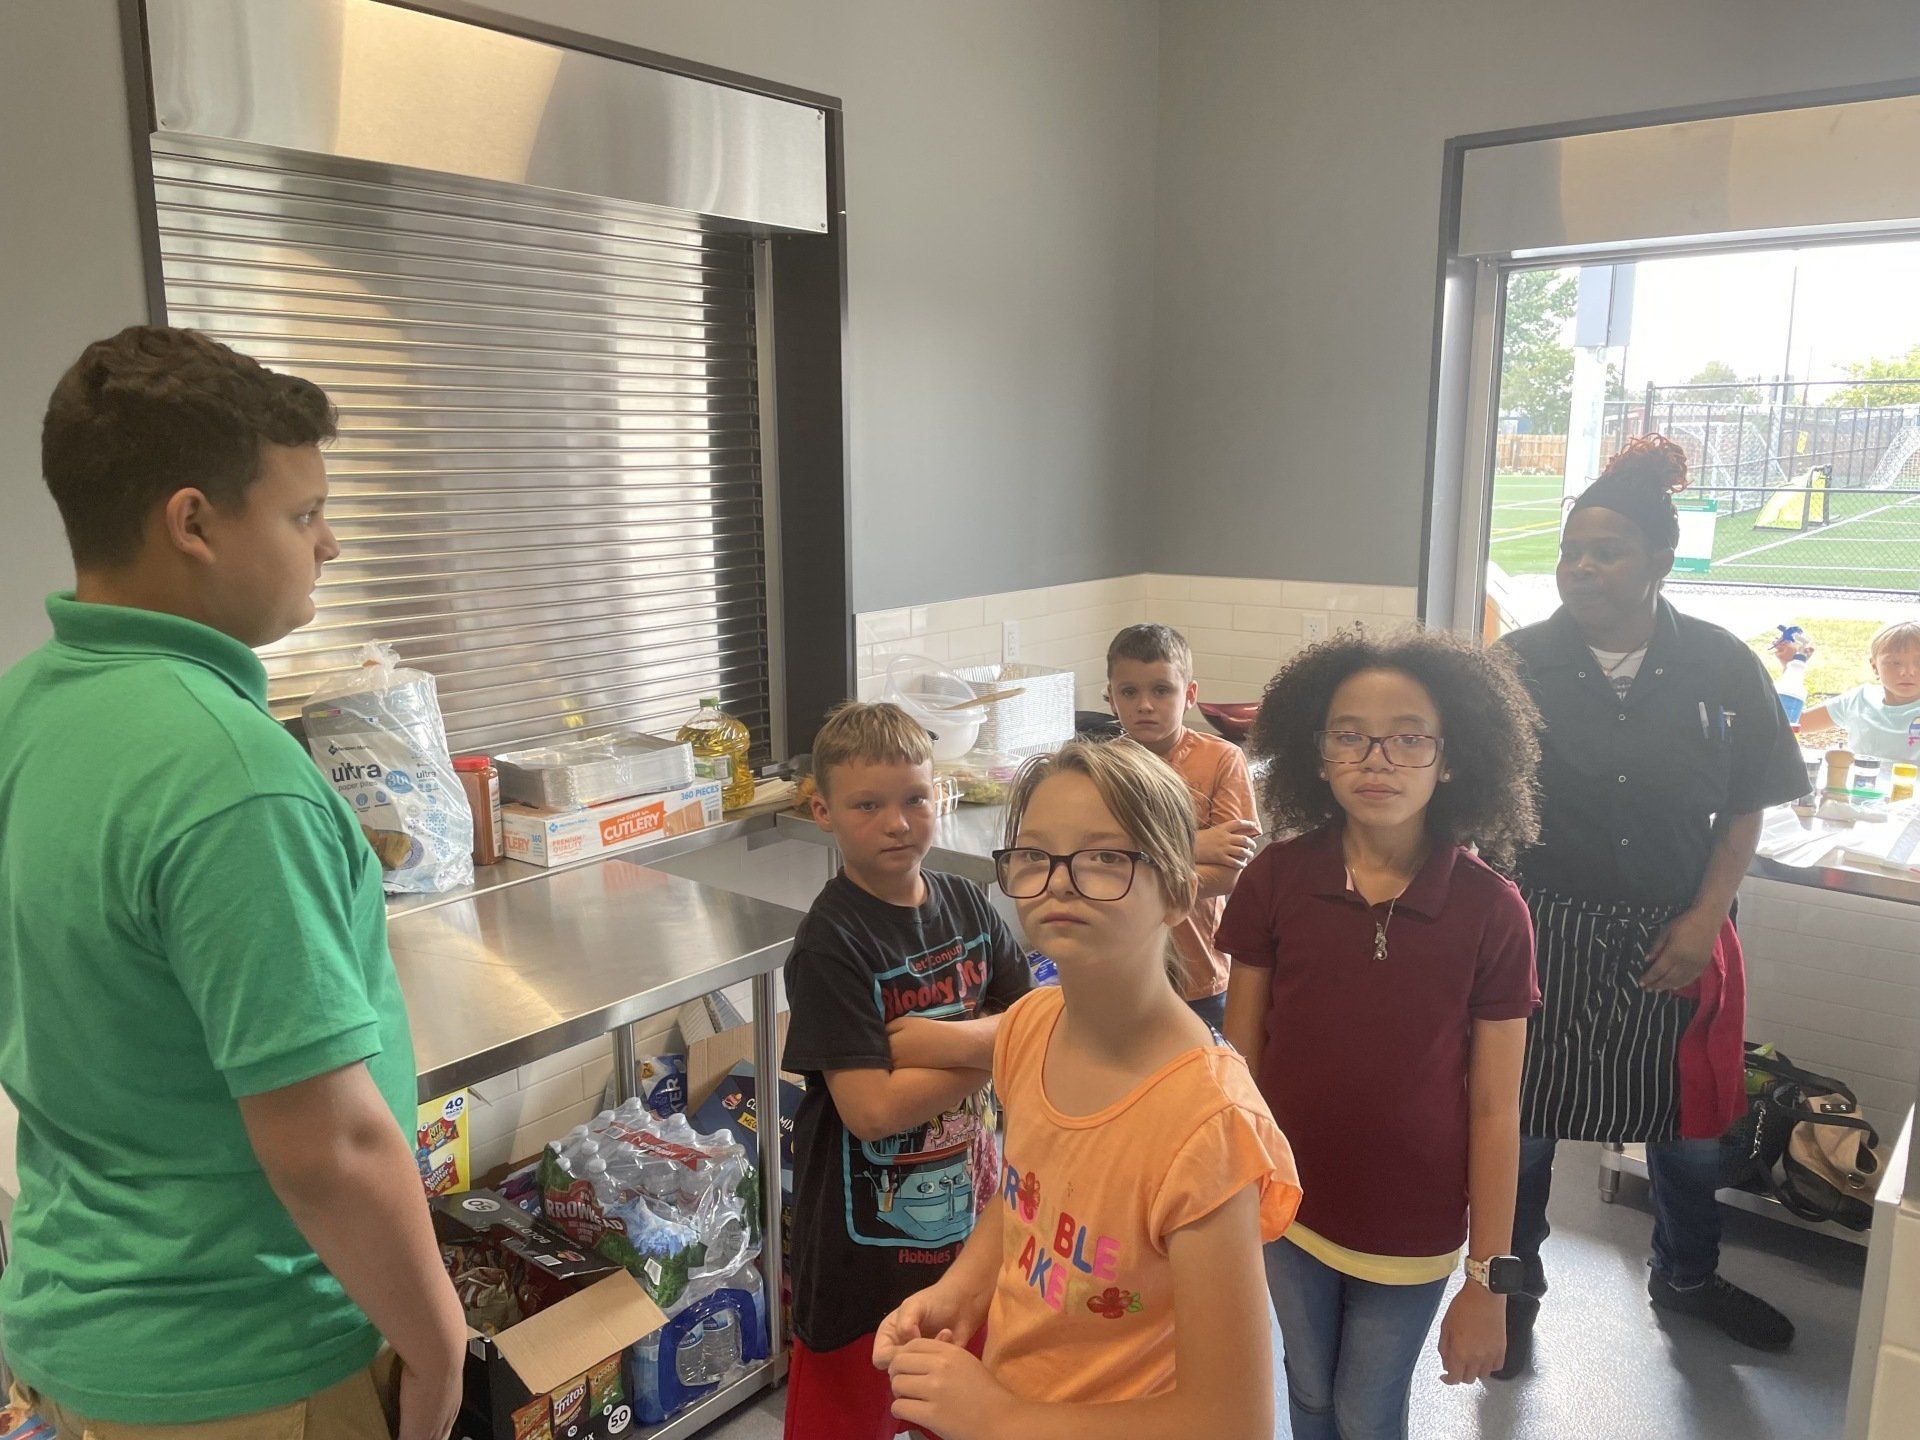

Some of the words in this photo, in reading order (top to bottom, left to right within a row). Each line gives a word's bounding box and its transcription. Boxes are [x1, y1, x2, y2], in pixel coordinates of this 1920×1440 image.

[331, 763, 382, 783] ultra
[416, 770, 436, 779] ultra
[695, 784, 720, 797] PIECES
[603, 811, 660, 841] CUTLERY
[503, 834, 530, 852] TLERY
[552, 834, 582, 846] PREMIUM
[553, 841, 582, 853] QUALITY
[445, 1096, 464, 1110] 40
[425, 1165, 446, 1187] Nutter
[898, 1248, 951, 1264] Hobbies
[554, 1384, 584, 1416] Fritos
[611, 1409, 628, 1428] 50
